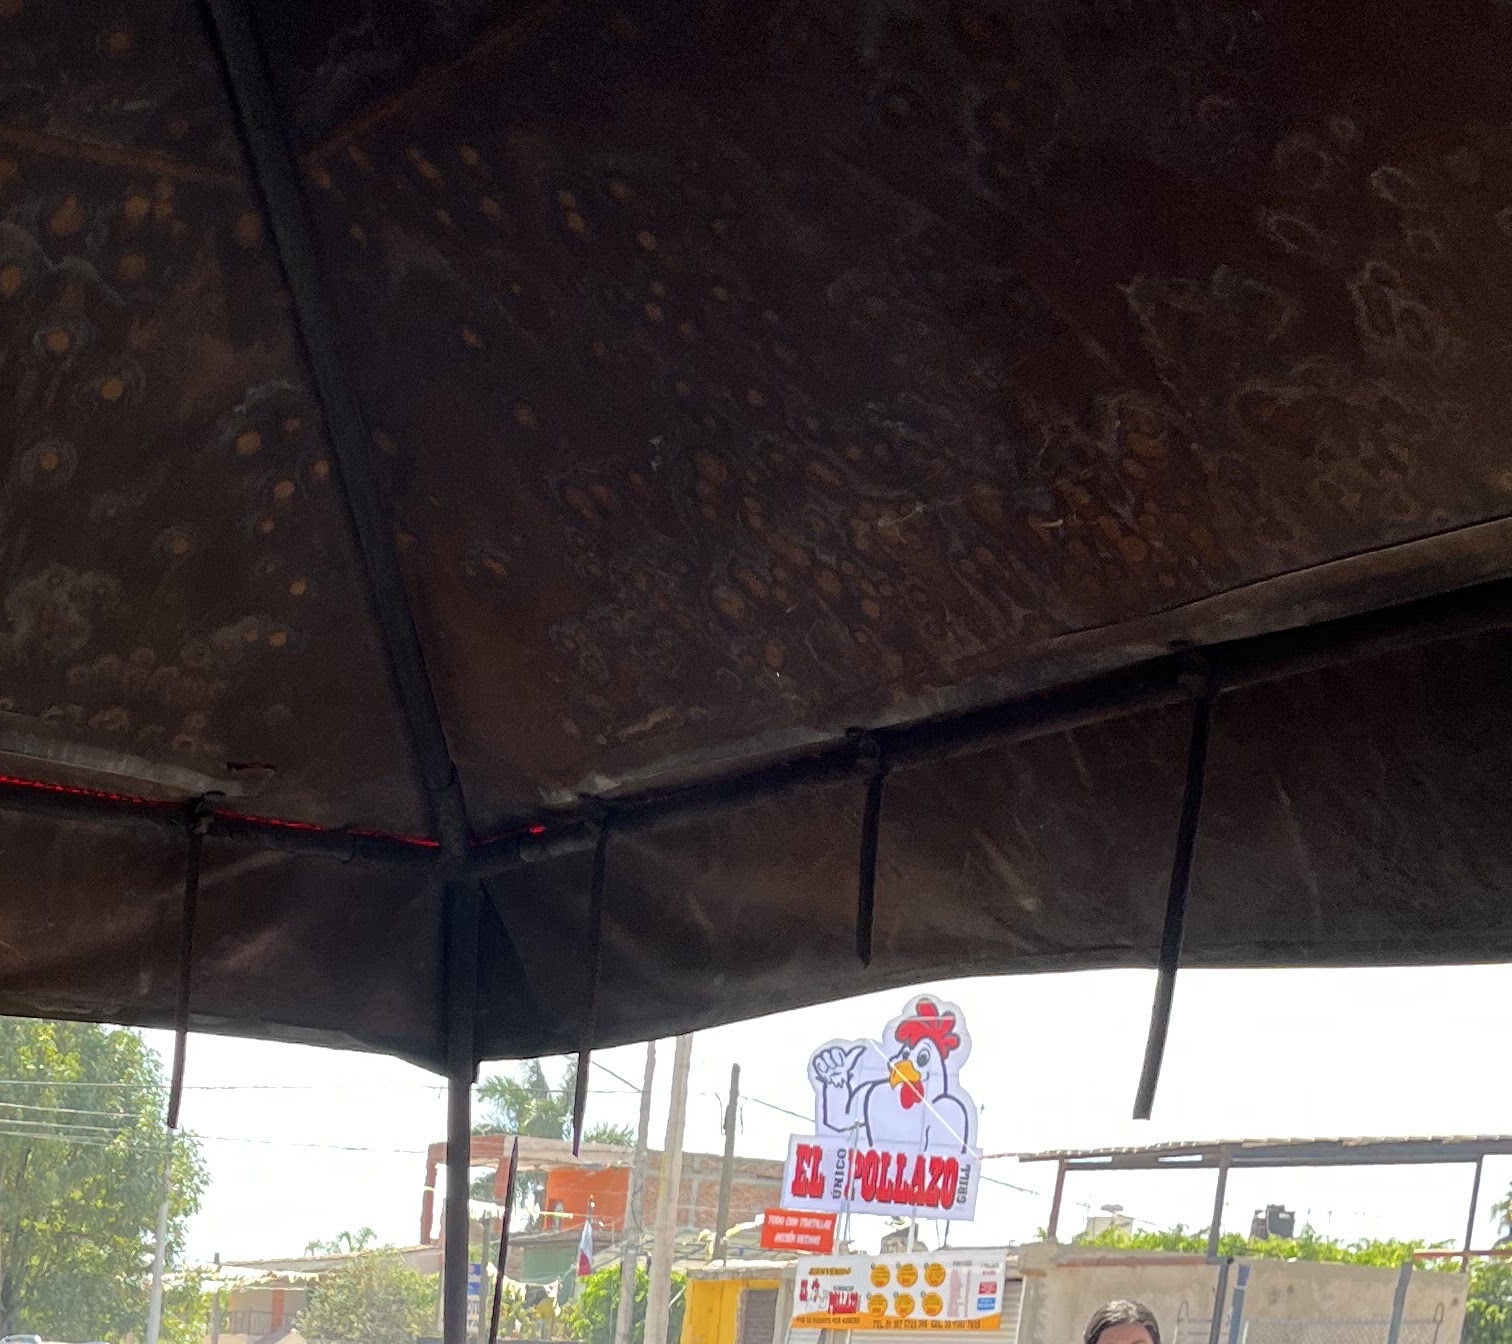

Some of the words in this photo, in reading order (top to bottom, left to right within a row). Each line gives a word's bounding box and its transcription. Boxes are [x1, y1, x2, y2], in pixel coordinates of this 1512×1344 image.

[792, 1144, 825, 1198] EL
[831, 1148, 847, 1200] ÚNICO
[844, 1148, 959, 1210] POLLAZO
[956, 1164, 971, 1204] GRILL
